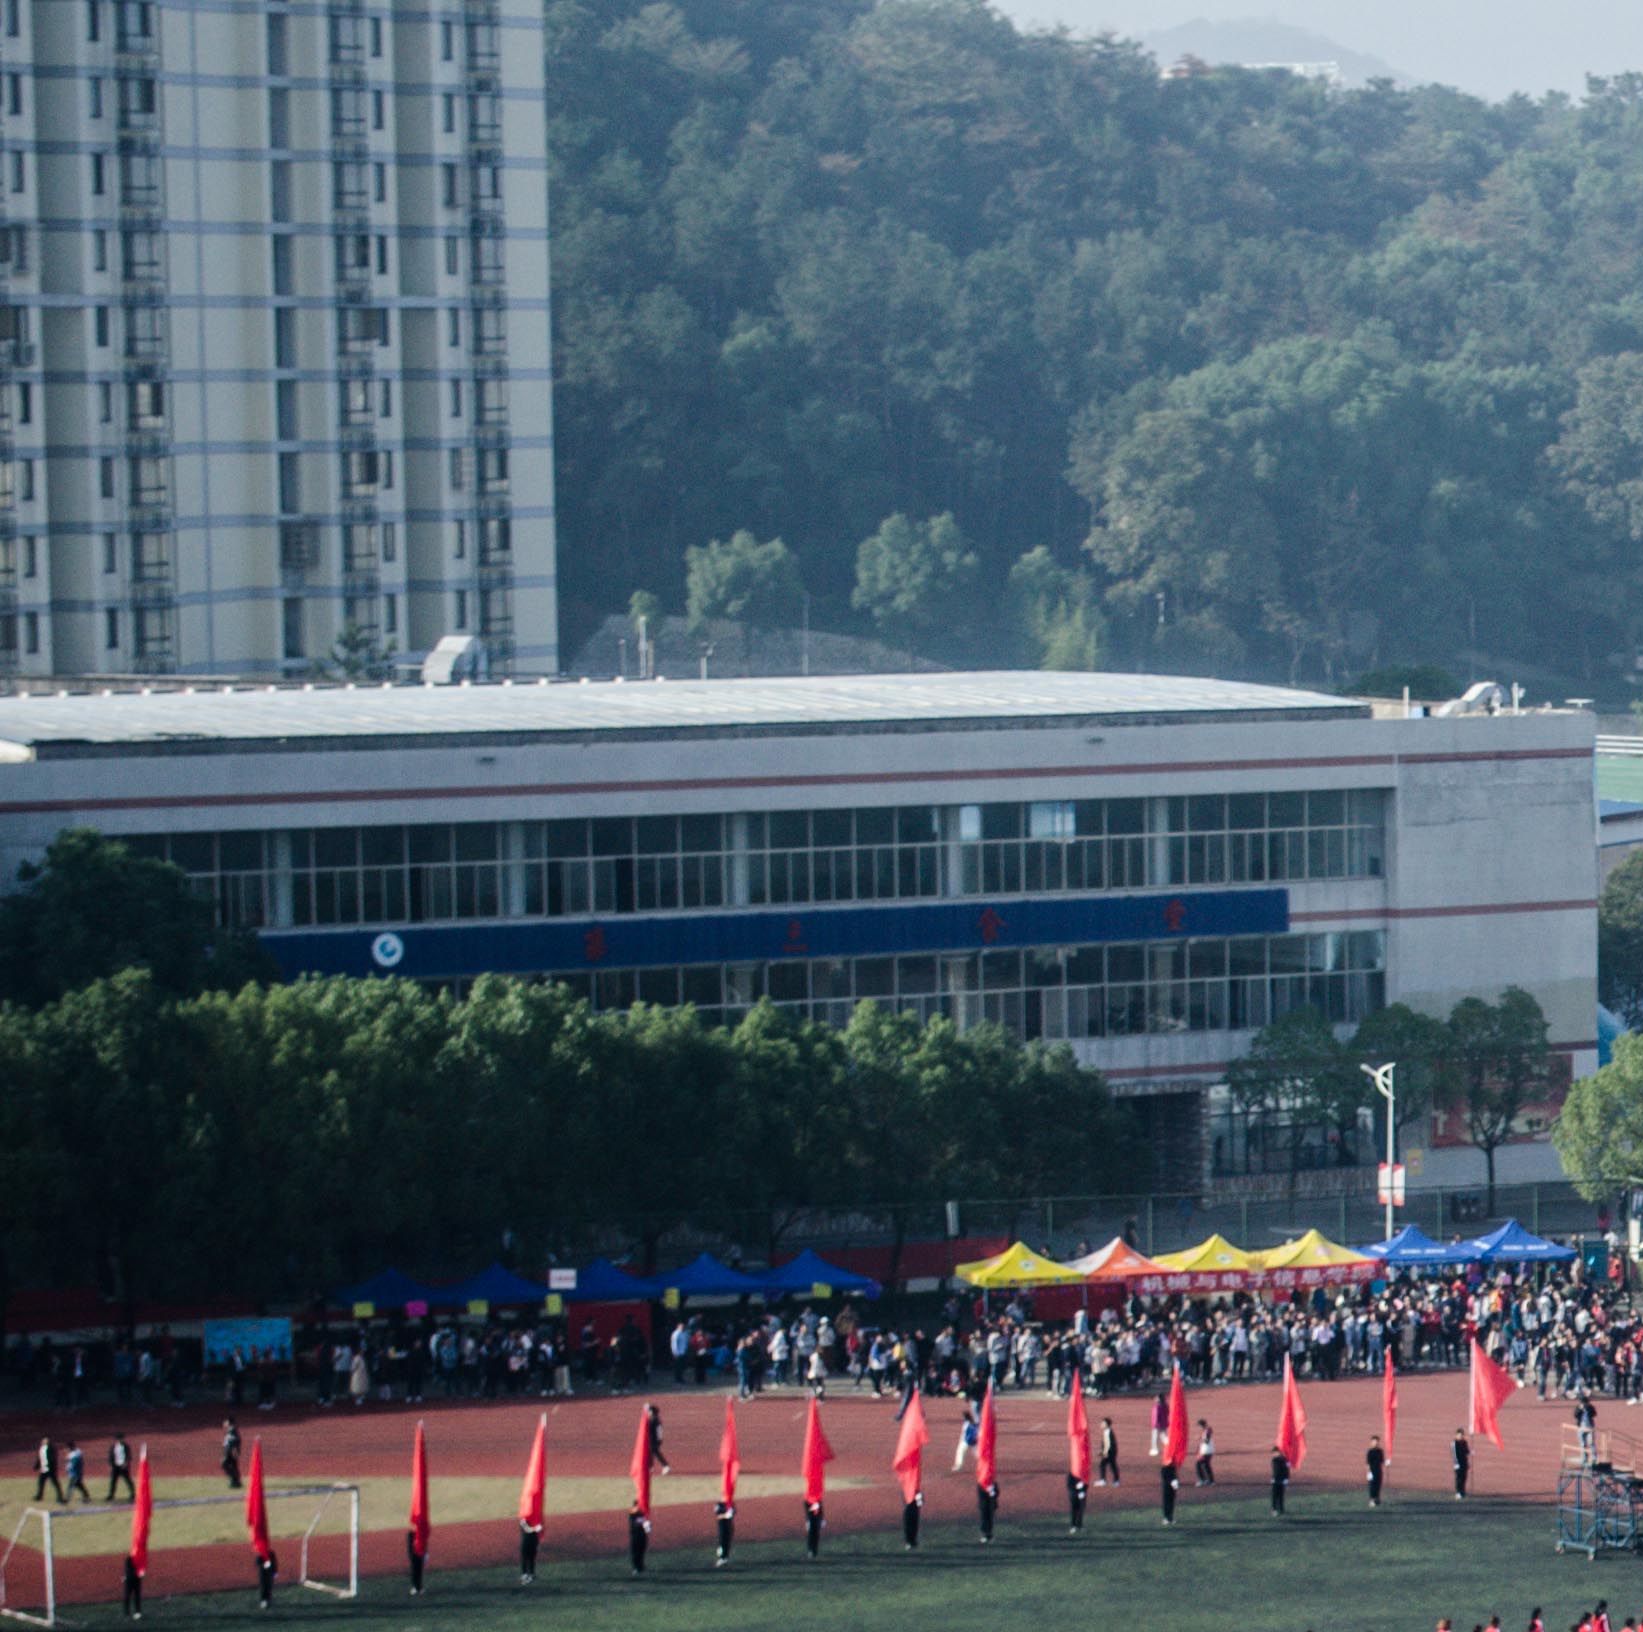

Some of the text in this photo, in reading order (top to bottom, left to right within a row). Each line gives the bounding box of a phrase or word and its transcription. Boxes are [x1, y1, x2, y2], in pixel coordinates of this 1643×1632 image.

[1142, 1264, 1377, 1292] 机械与电子信息学院
